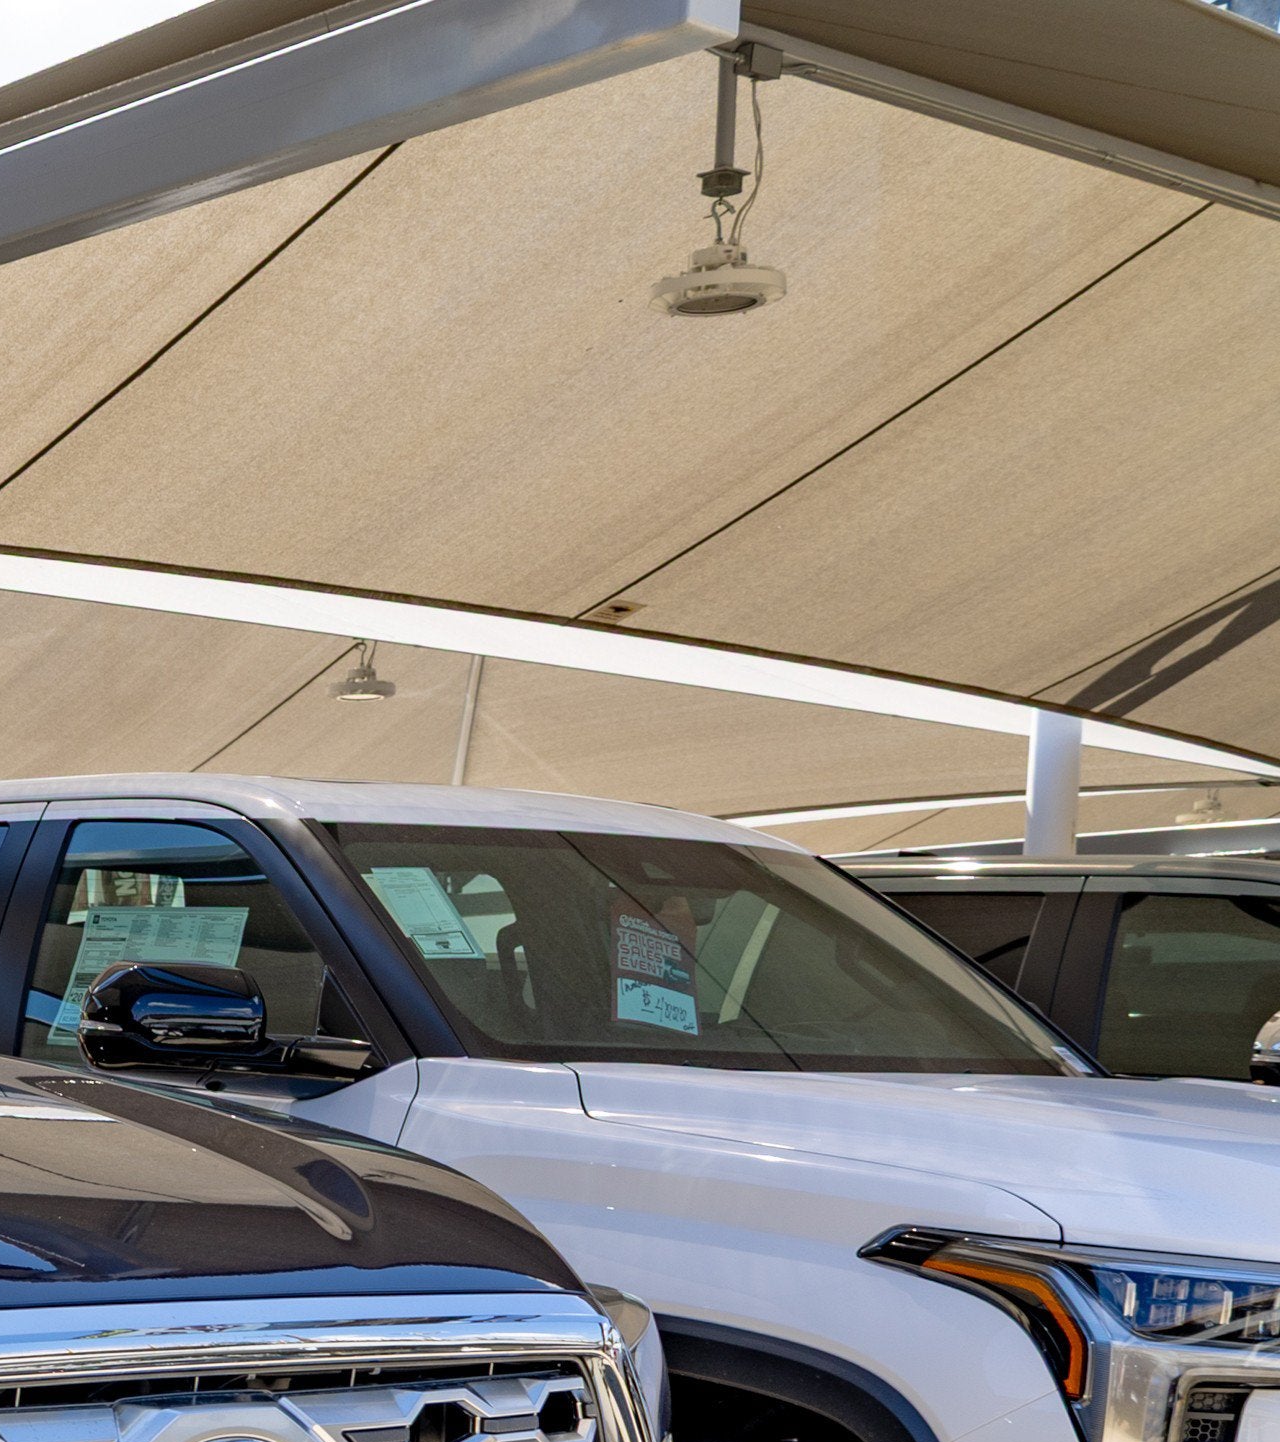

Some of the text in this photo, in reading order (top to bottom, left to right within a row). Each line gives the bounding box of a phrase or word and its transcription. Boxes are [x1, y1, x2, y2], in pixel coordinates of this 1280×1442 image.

[618, 931, 681, 957] TAILGATE
[620, 943, 663, 963] SALES
[620, 957, 664, 976] EVENT
